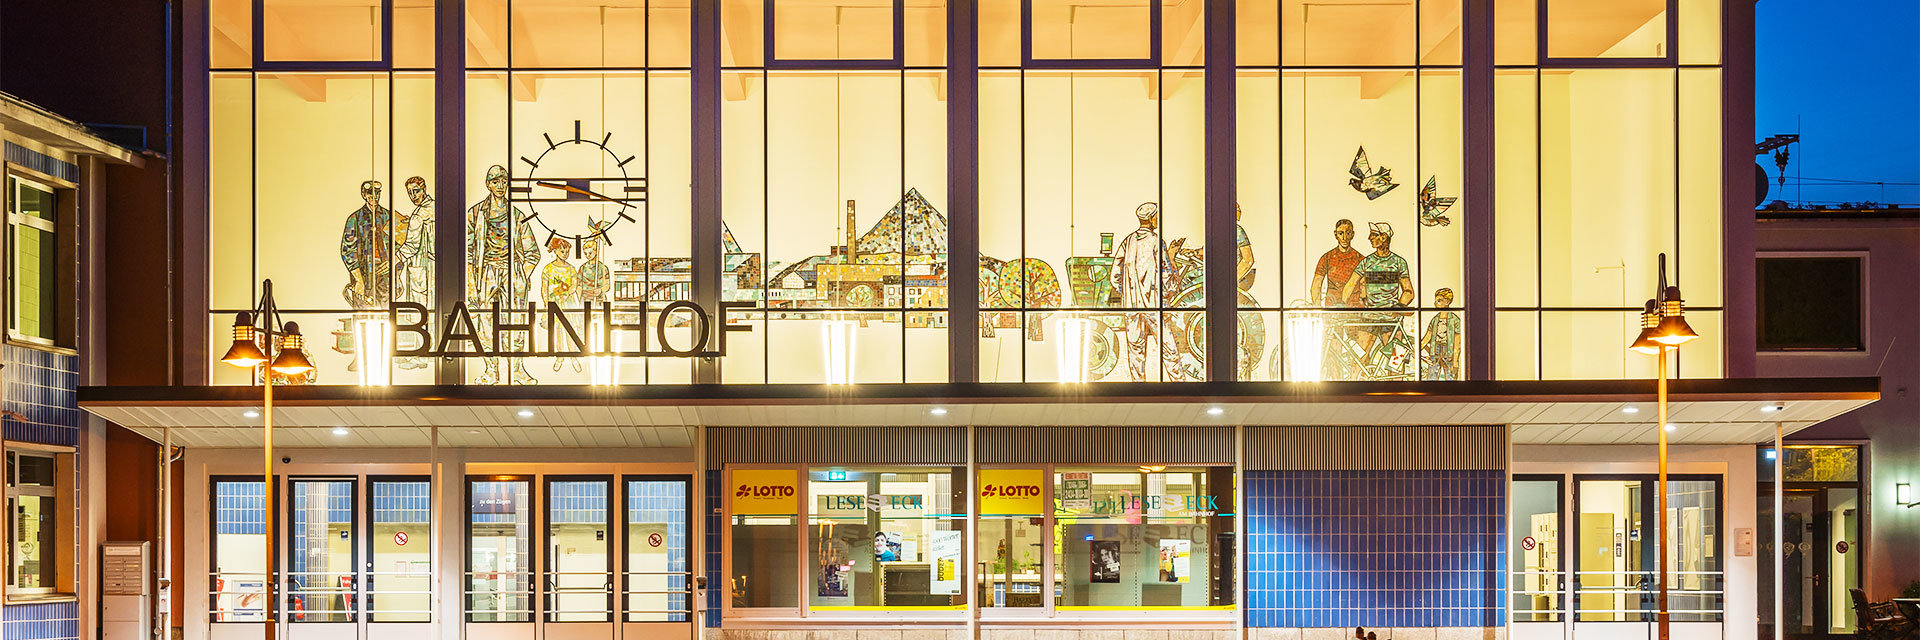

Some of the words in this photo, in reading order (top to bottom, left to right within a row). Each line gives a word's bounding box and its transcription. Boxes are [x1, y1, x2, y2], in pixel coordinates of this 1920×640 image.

[390, 300, 757, 357] BAHNHOF
[753, 485, 795, 497] LOTTO
[999, 485, 1040, 497] LOTTO
[826, 495, 866, 510] LESE
[891, 495, 923, 510] ECK
[1120, 495, 1161, 510] LESE
[1186, 495, 1219, 510] ECK
